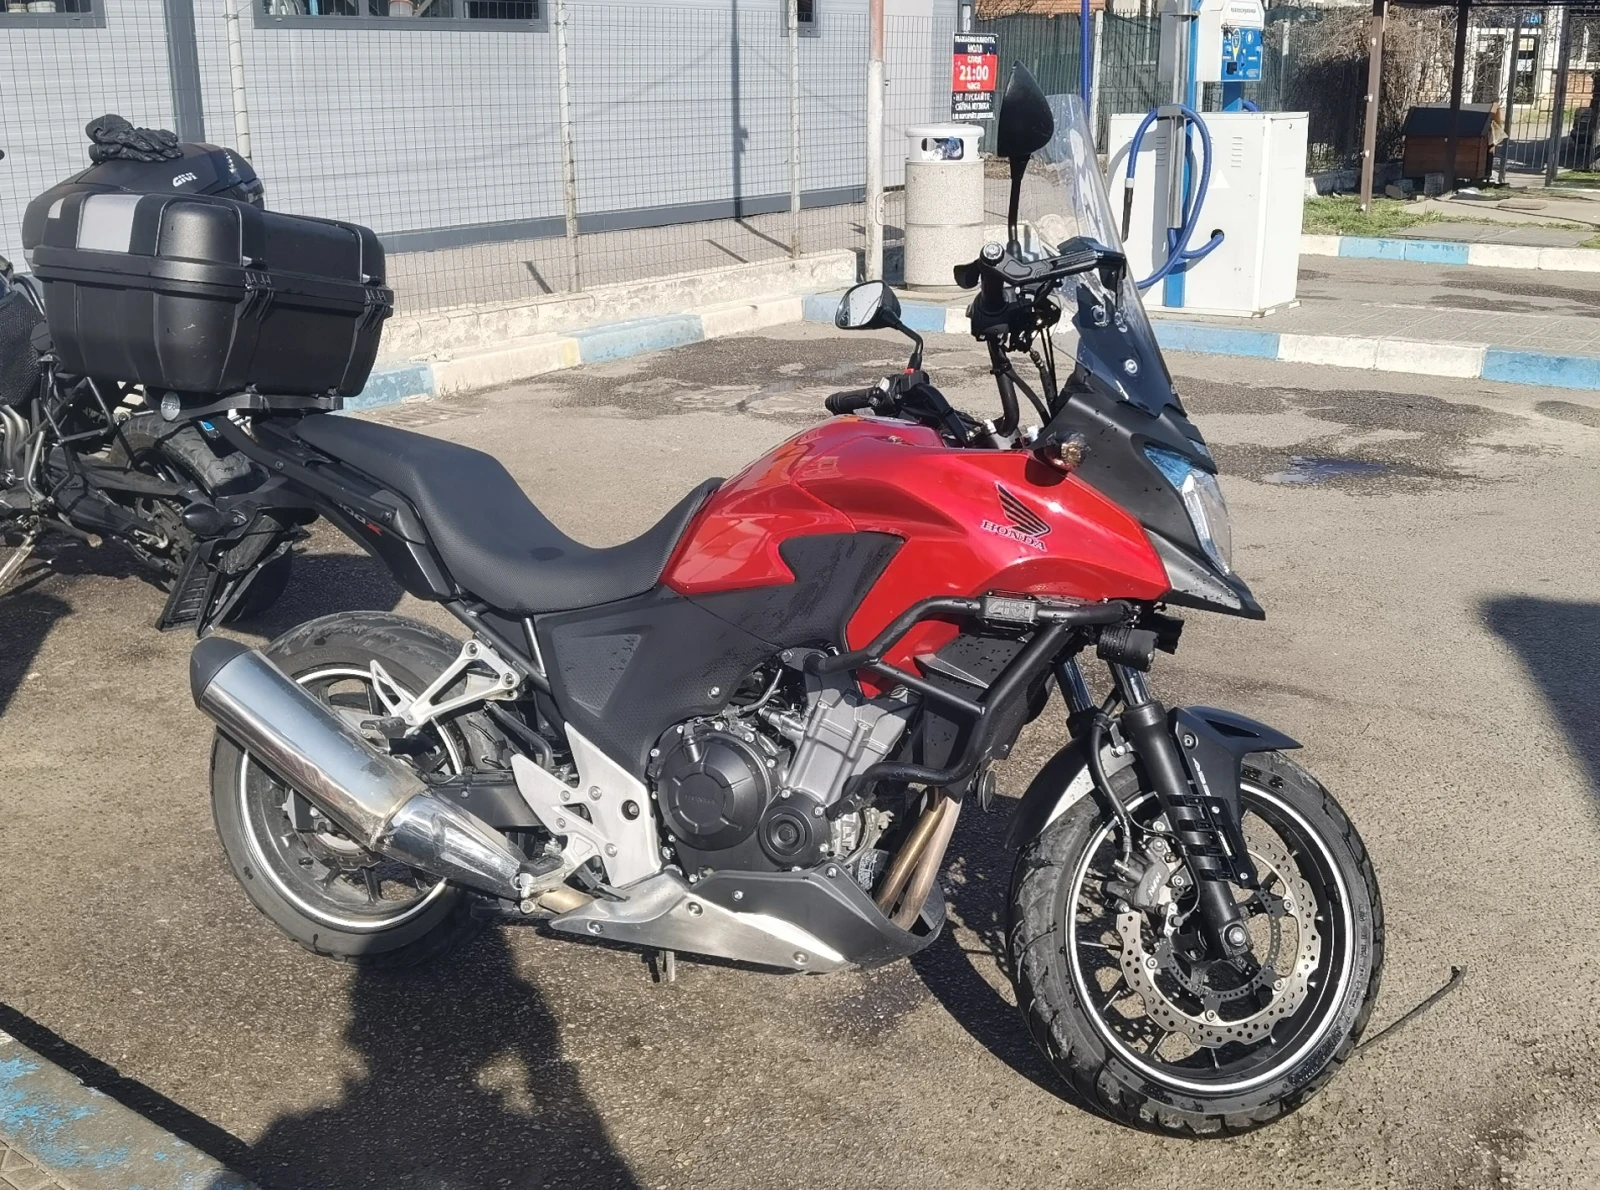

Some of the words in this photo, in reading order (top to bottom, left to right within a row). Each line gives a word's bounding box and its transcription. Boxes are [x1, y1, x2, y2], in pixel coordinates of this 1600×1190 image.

[959, 65, 989, 80] 21:00
[172, 172, 198, 187] GIVI
[981, 519, 1048, 552] HONDA
[988, 600, 1031, 618] GIVI
